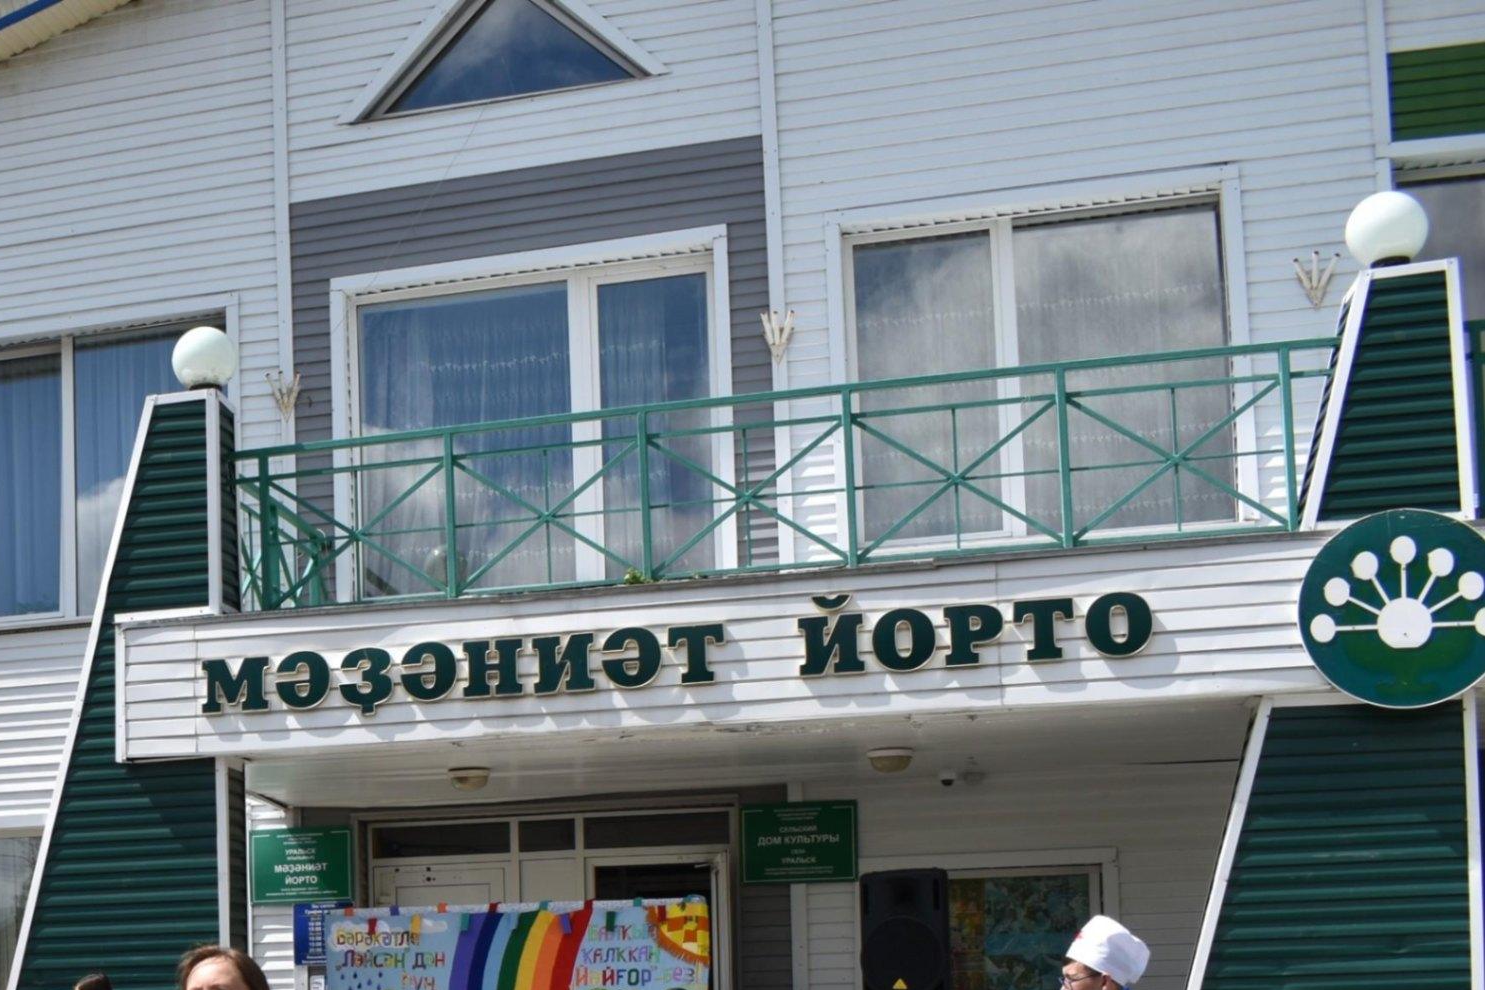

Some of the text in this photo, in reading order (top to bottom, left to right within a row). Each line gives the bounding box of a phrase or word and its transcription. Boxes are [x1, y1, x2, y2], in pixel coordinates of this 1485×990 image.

[202, 592, 1153, 715] МӘҘӘНИӘТ ЙОРТО
[757, 834, 840, 847] ДОМ КУЛЬТУРЫ
[285, 875, 317, 885] ЙОРТО
